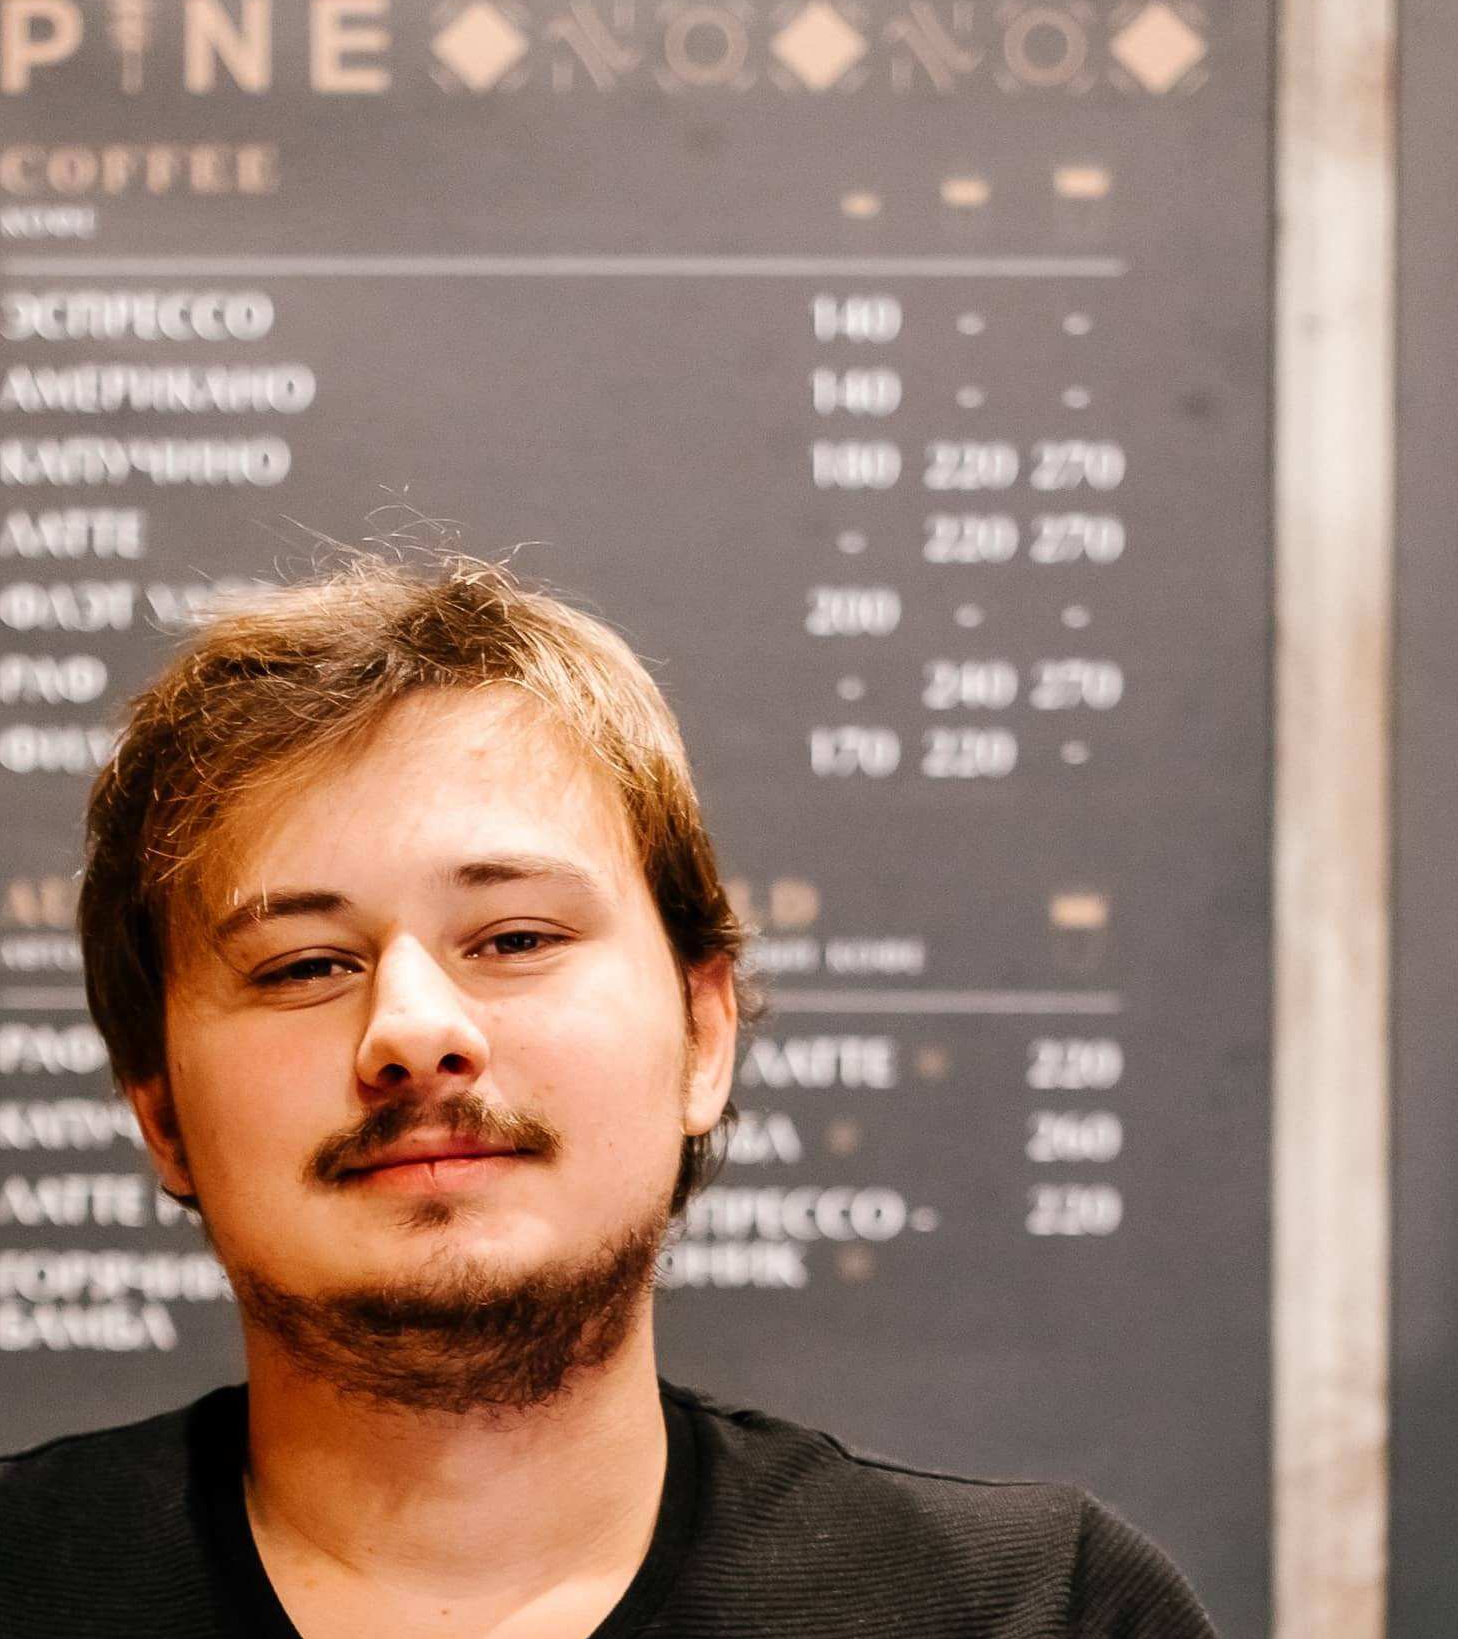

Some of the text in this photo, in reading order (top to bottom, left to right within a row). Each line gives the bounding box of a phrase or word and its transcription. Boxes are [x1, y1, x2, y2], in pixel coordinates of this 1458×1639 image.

[5, 290, 274, 339] ЭСПРЕССО
[1, 363, 316, 411] АМЕРИКАНО
[0, 437, 291, 484] КАПУЧИНО
[0, 509, 143, 557] ЛАТТЕ
[1029, 1040, 1122, 1089] 220
[1029, 1113, 1122, 1161] 260
[1028, 1186, 1122, 1235] 220
